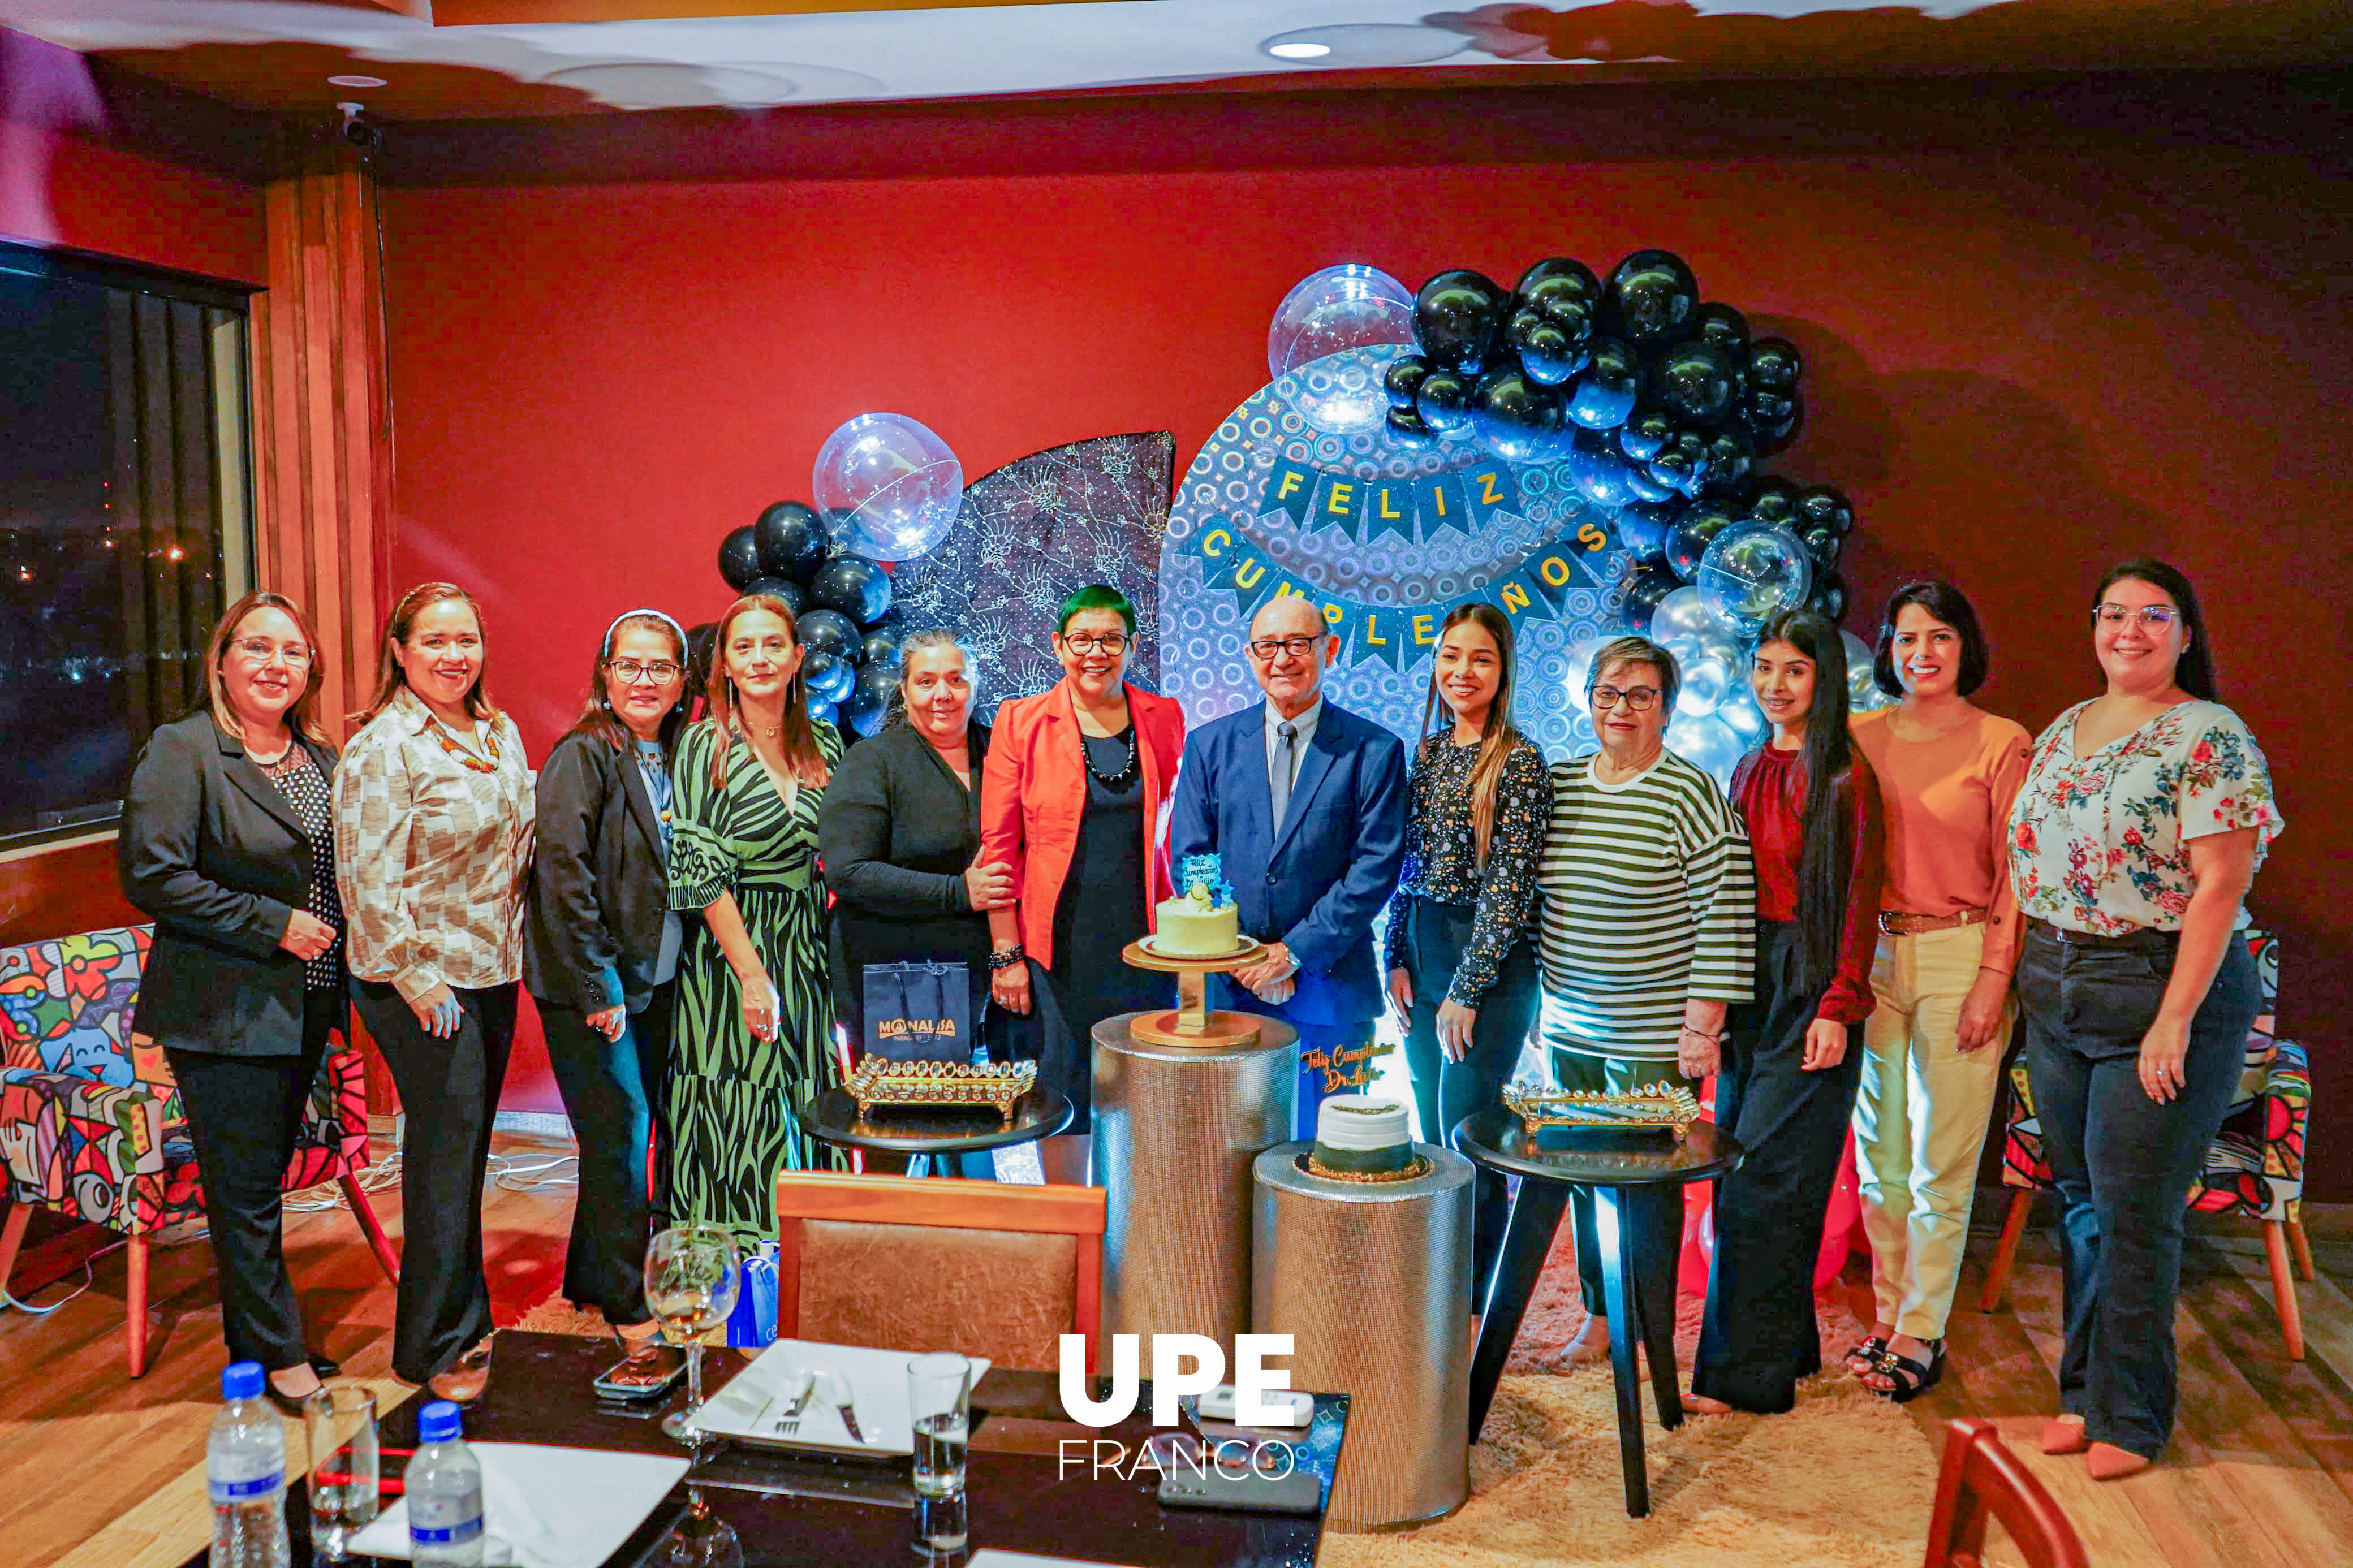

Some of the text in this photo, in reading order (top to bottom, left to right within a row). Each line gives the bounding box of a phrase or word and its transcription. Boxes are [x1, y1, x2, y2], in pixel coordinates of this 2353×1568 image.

[1277, 470, 1504, 519] FELIZ
[1203, 523, 1607, 645] CUPLEÑOS
[878, 1018, 955, 1034] MONALISA
